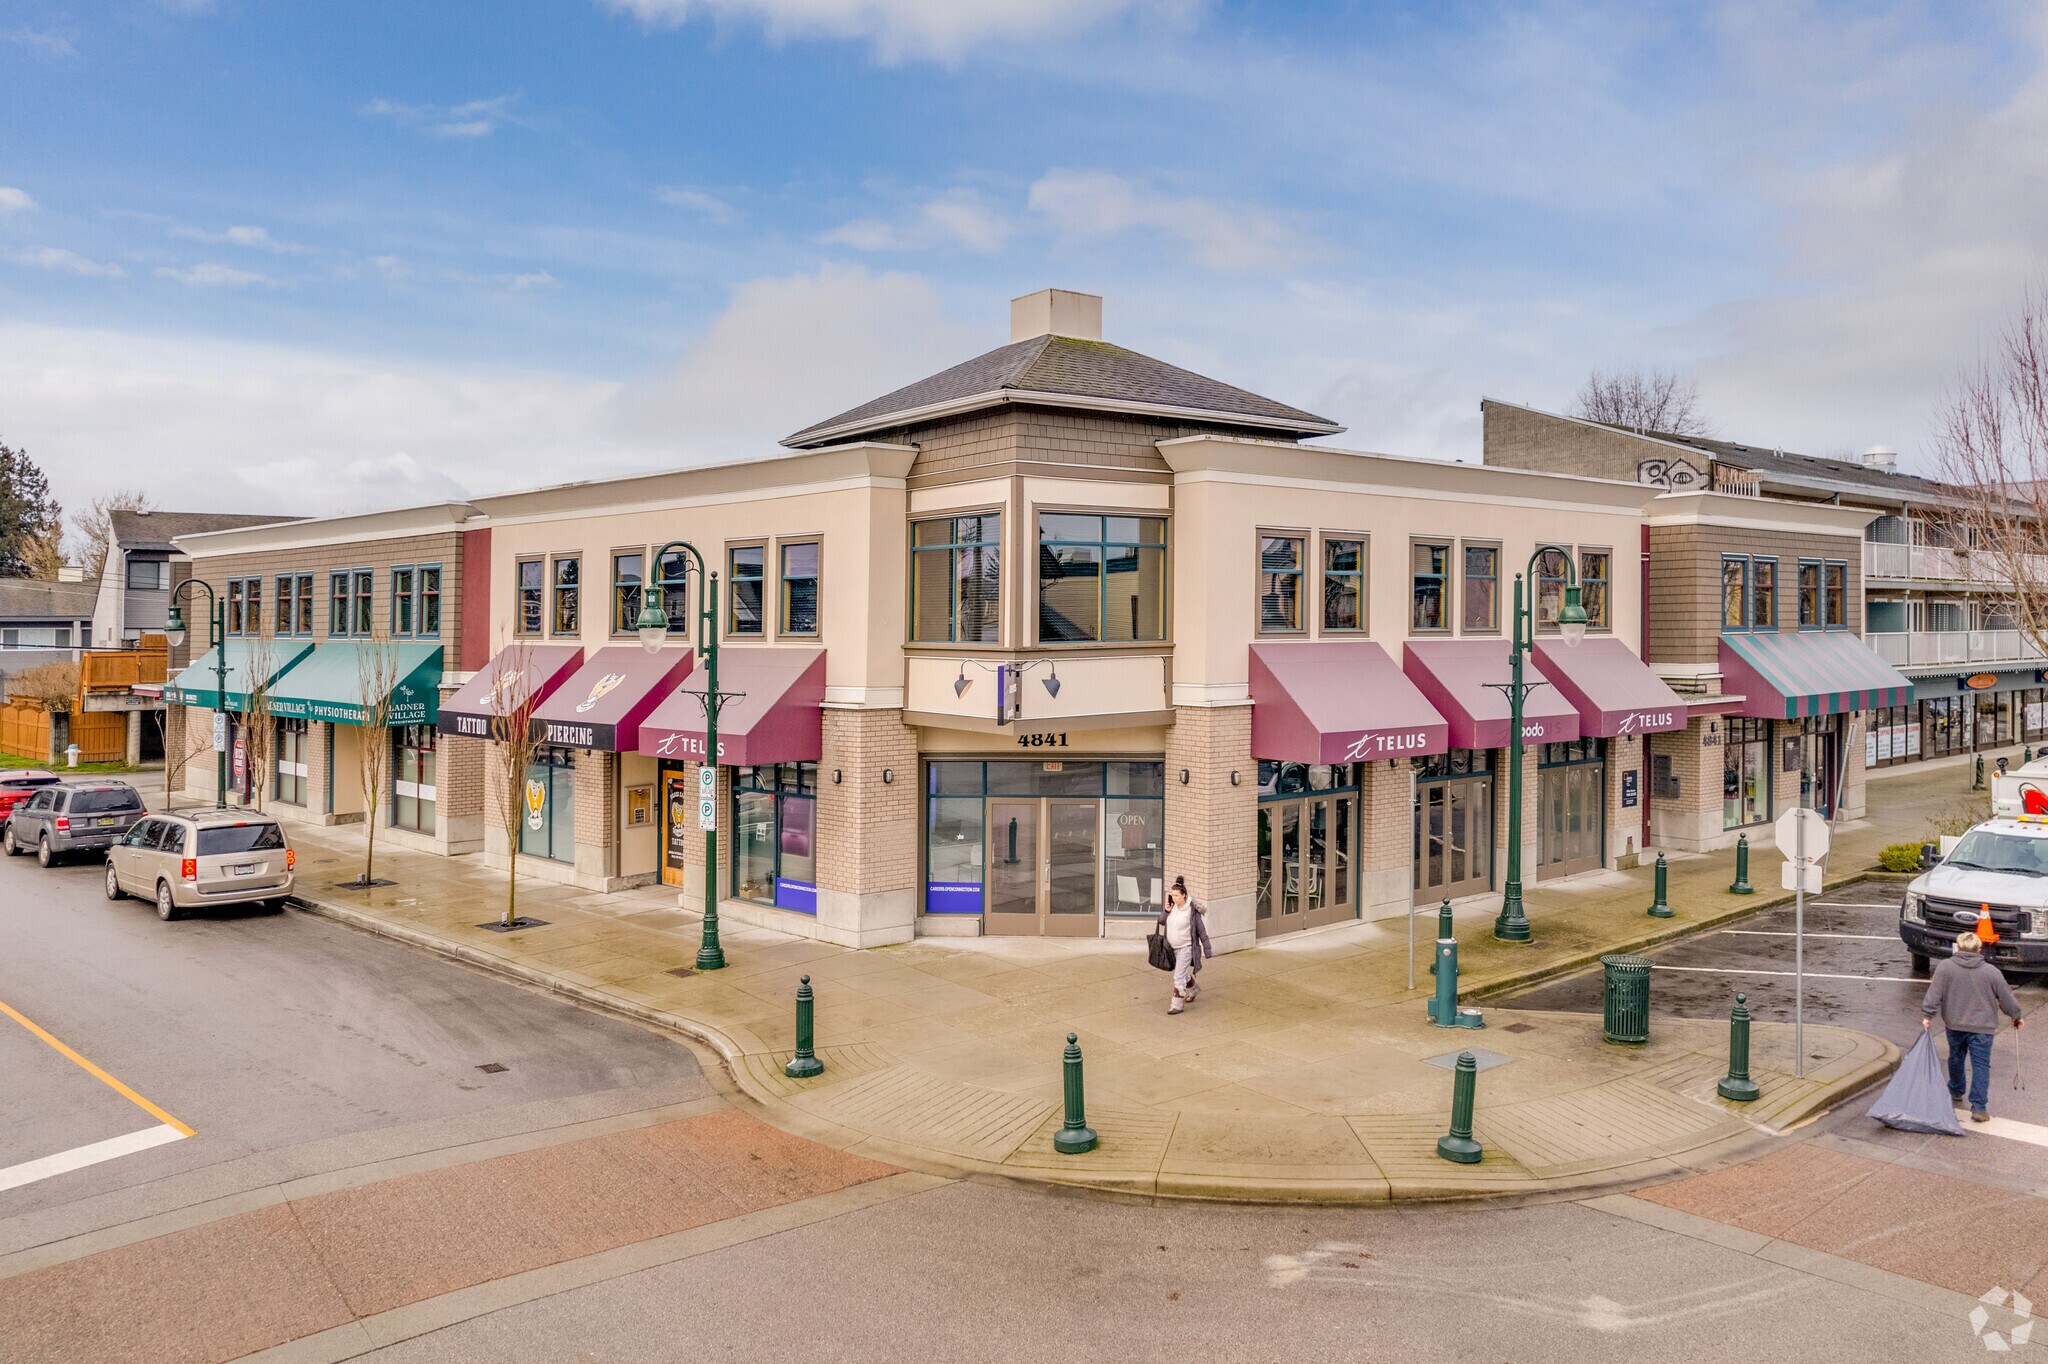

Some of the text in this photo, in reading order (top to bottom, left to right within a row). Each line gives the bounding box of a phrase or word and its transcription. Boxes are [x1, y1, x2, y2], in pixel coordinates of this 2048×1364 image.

[284, 702, 306, 714] VILLAGE
[314, 705, 370, 722] PHYSIOTHERAP
[388, 703, 425, 712] LADNER
[388, 711, 426, 720] VILLAGE
[457, 716, 487, 736] TATTOO
[1638, 712, 1673, 728] TELUS
[547, 724, 593, 746] PIERCING
[1521, 722, 1544, 738] oodo
[681, 737, 725, 757] TELS
[1017, 732, 1069, 747] 4841
[1376, 732, 1426, 752] TELUS
[1119, 814, 1146, 826] OPEN
